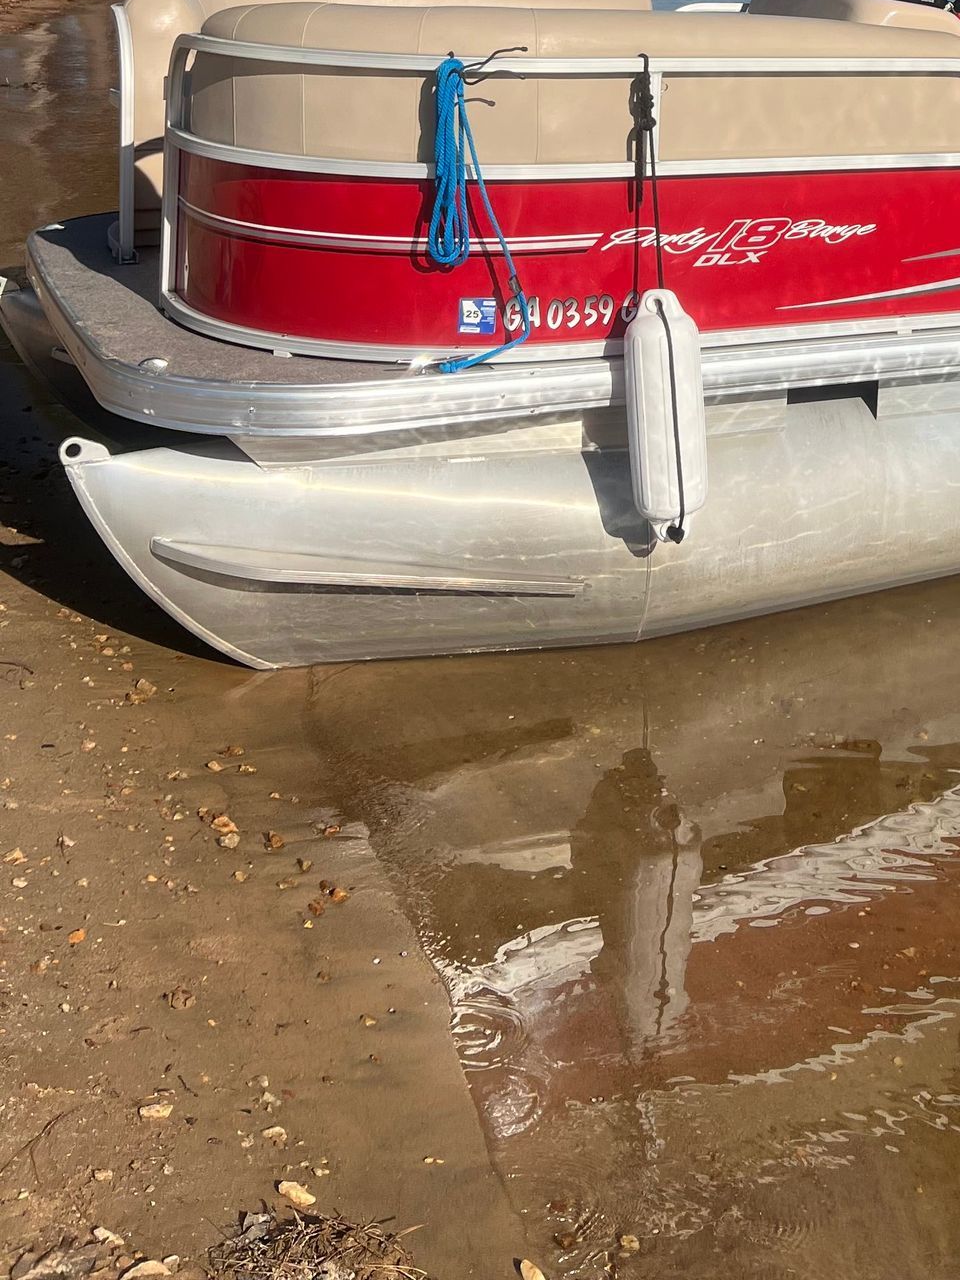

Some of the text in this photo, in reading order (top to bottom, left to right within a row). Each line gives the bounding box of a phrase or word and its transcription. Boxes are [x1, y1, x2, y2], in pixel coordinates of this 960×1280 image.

[601, 217, 877, 254] Party 18 Barge
[693, 250, 768, 267] DLX
[466, 310, 480, 319] 25
[503, 295, 541, 332] GA
[546, 292, 615, 330] 0359
